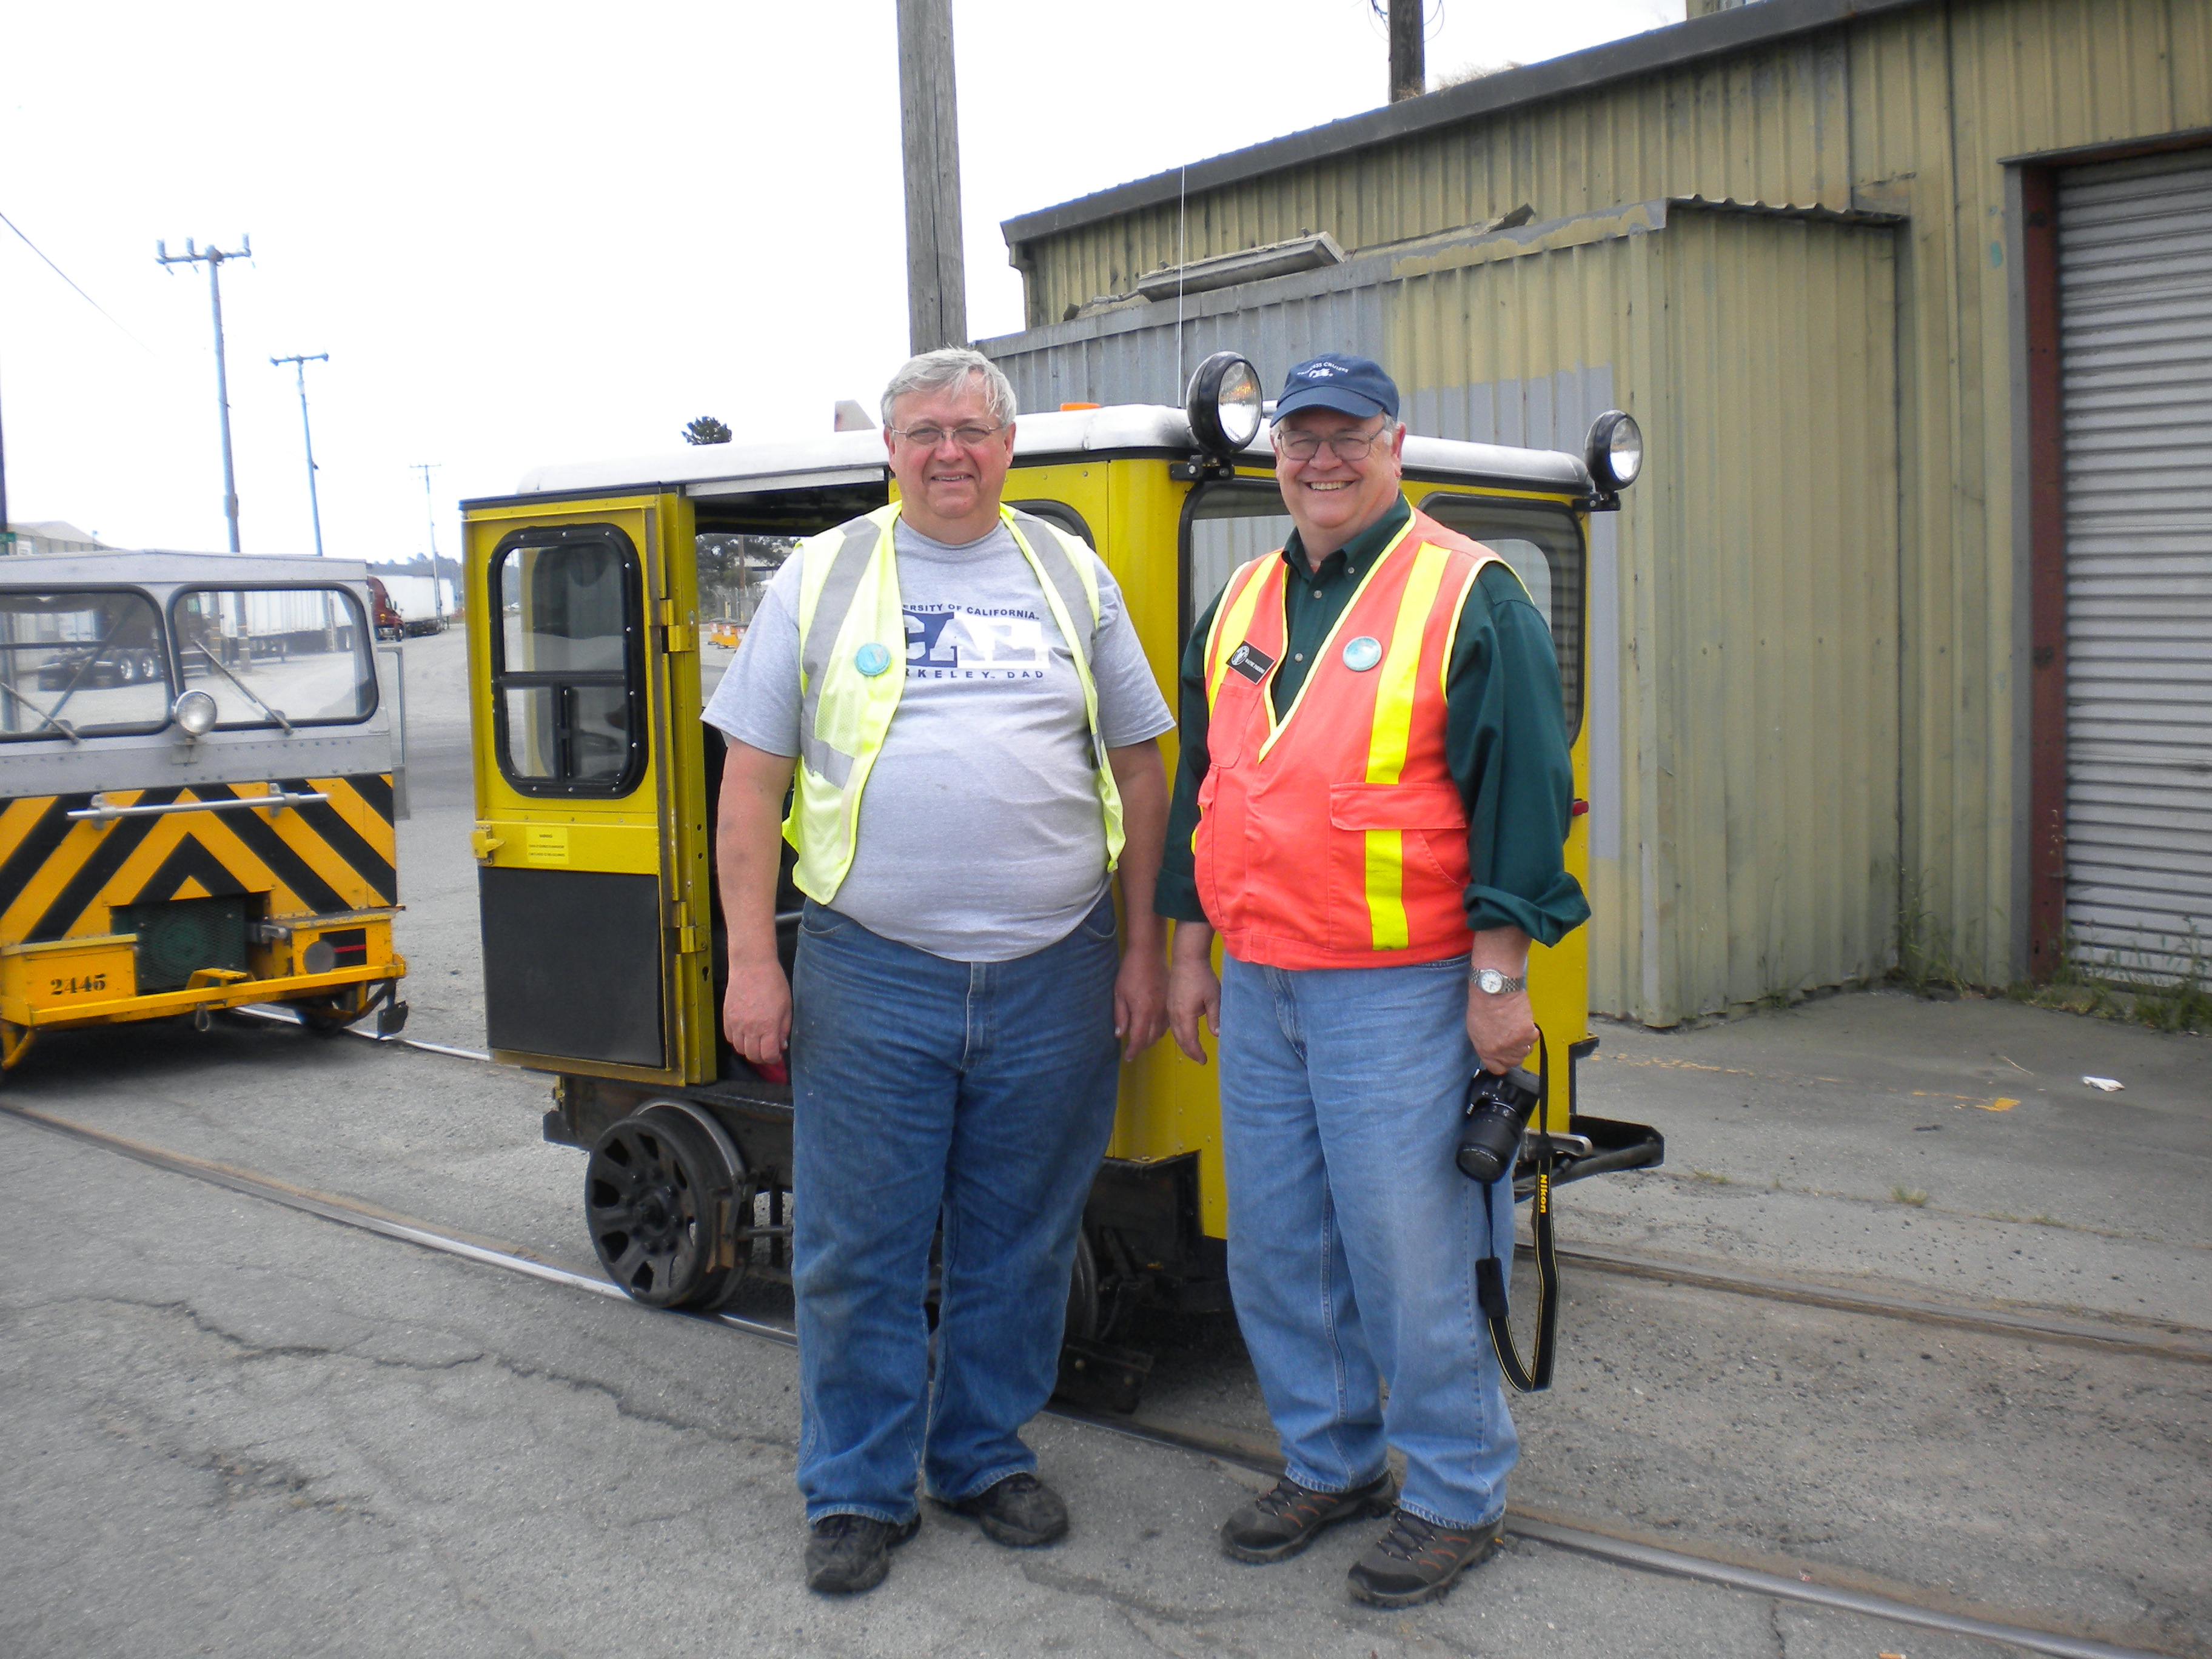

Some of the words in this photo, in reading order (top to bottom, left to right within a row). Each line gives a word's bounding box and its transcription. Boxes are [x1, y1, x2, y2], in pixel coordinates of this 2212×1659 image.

[902, 603, 943, 612] ERSITY
[967, 607, 1036, 620] CALIFORNIA
[1007, 670, 1044, 679] DAD
[50, 973, 106, 995] 2445
[1540, 1173, 1548, 1213] Nikon
